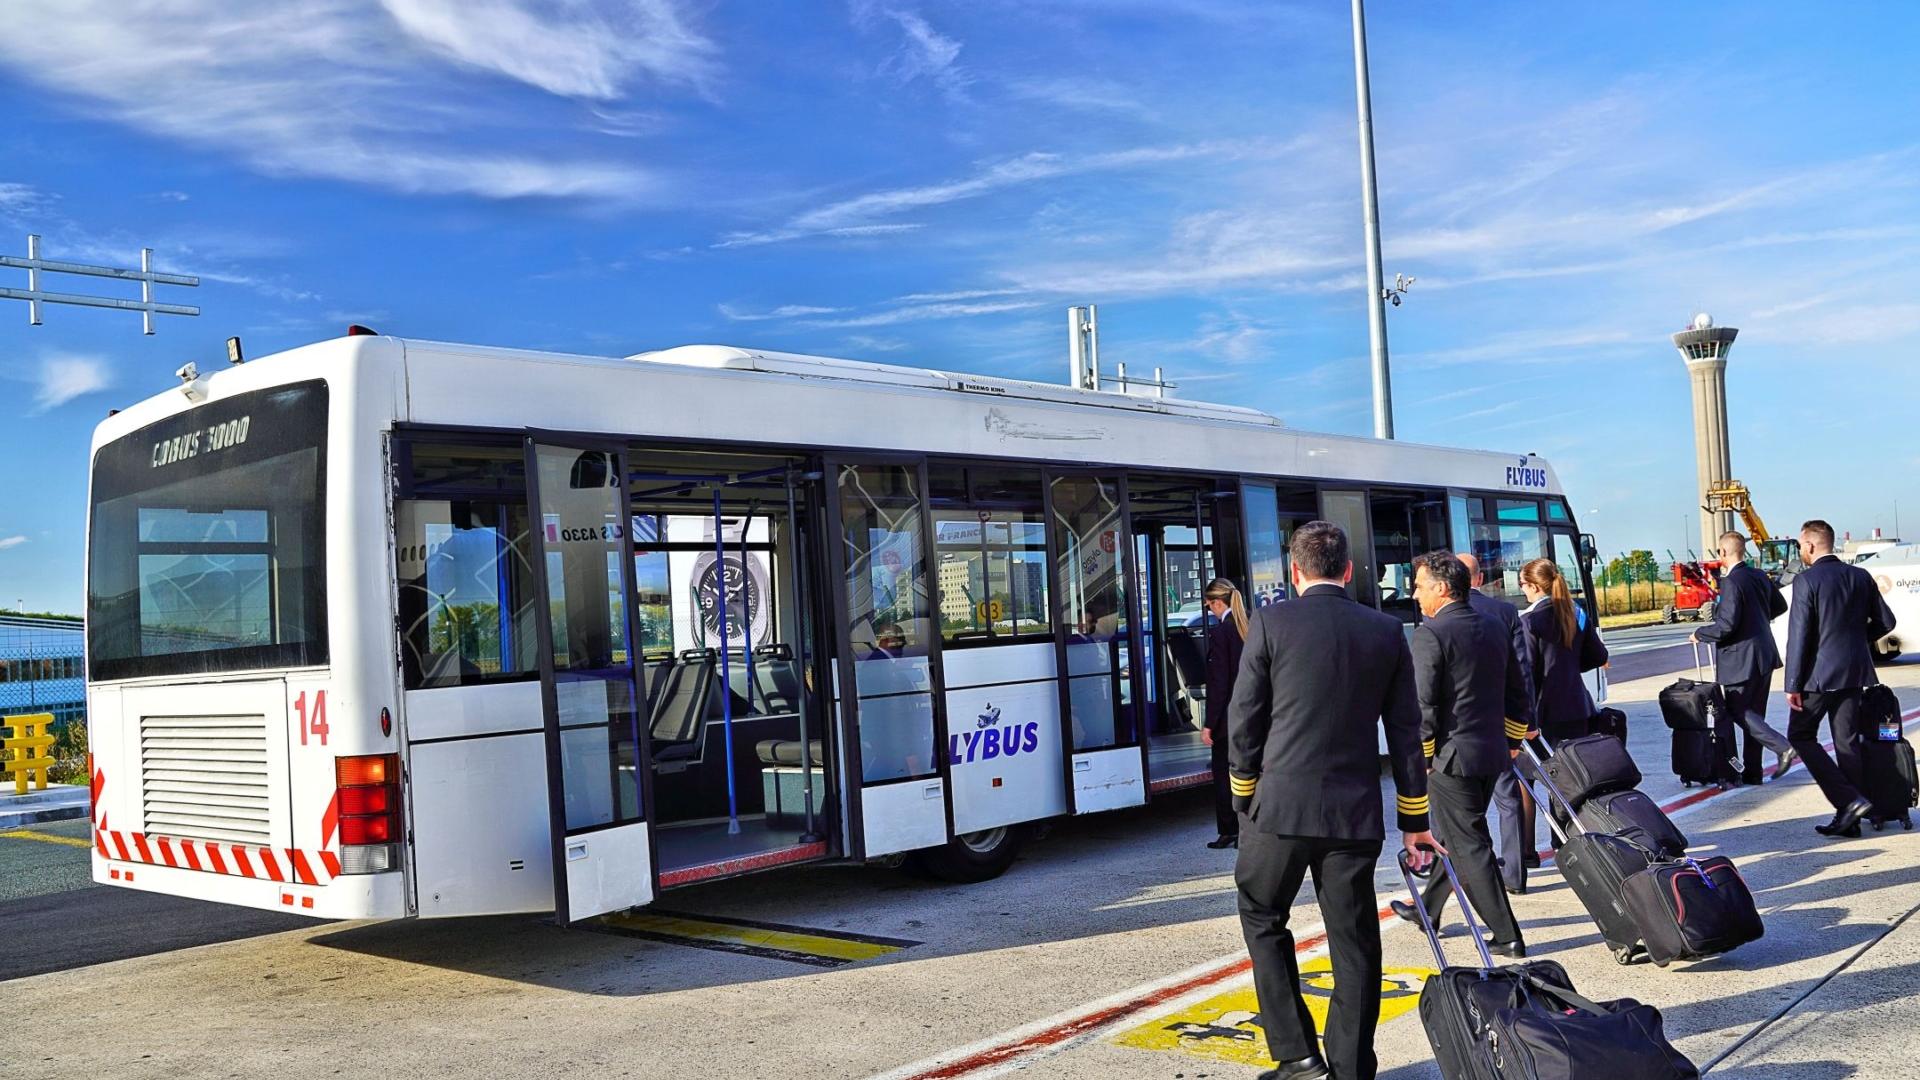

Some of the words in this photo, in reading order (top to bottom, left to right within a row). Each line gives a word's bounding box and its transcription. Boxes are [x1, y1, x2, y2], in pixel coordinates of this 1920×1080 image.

[1506, 466, 1545, 487] FLYBUS
[947, 528, 982, 541] FRANC
[1896, 579, 1920, 589] alyzi
[705, 597, 714, 609] 9
[295, 690, 329, 746] 14
[931, 721, 1039, 768] LYBUS
